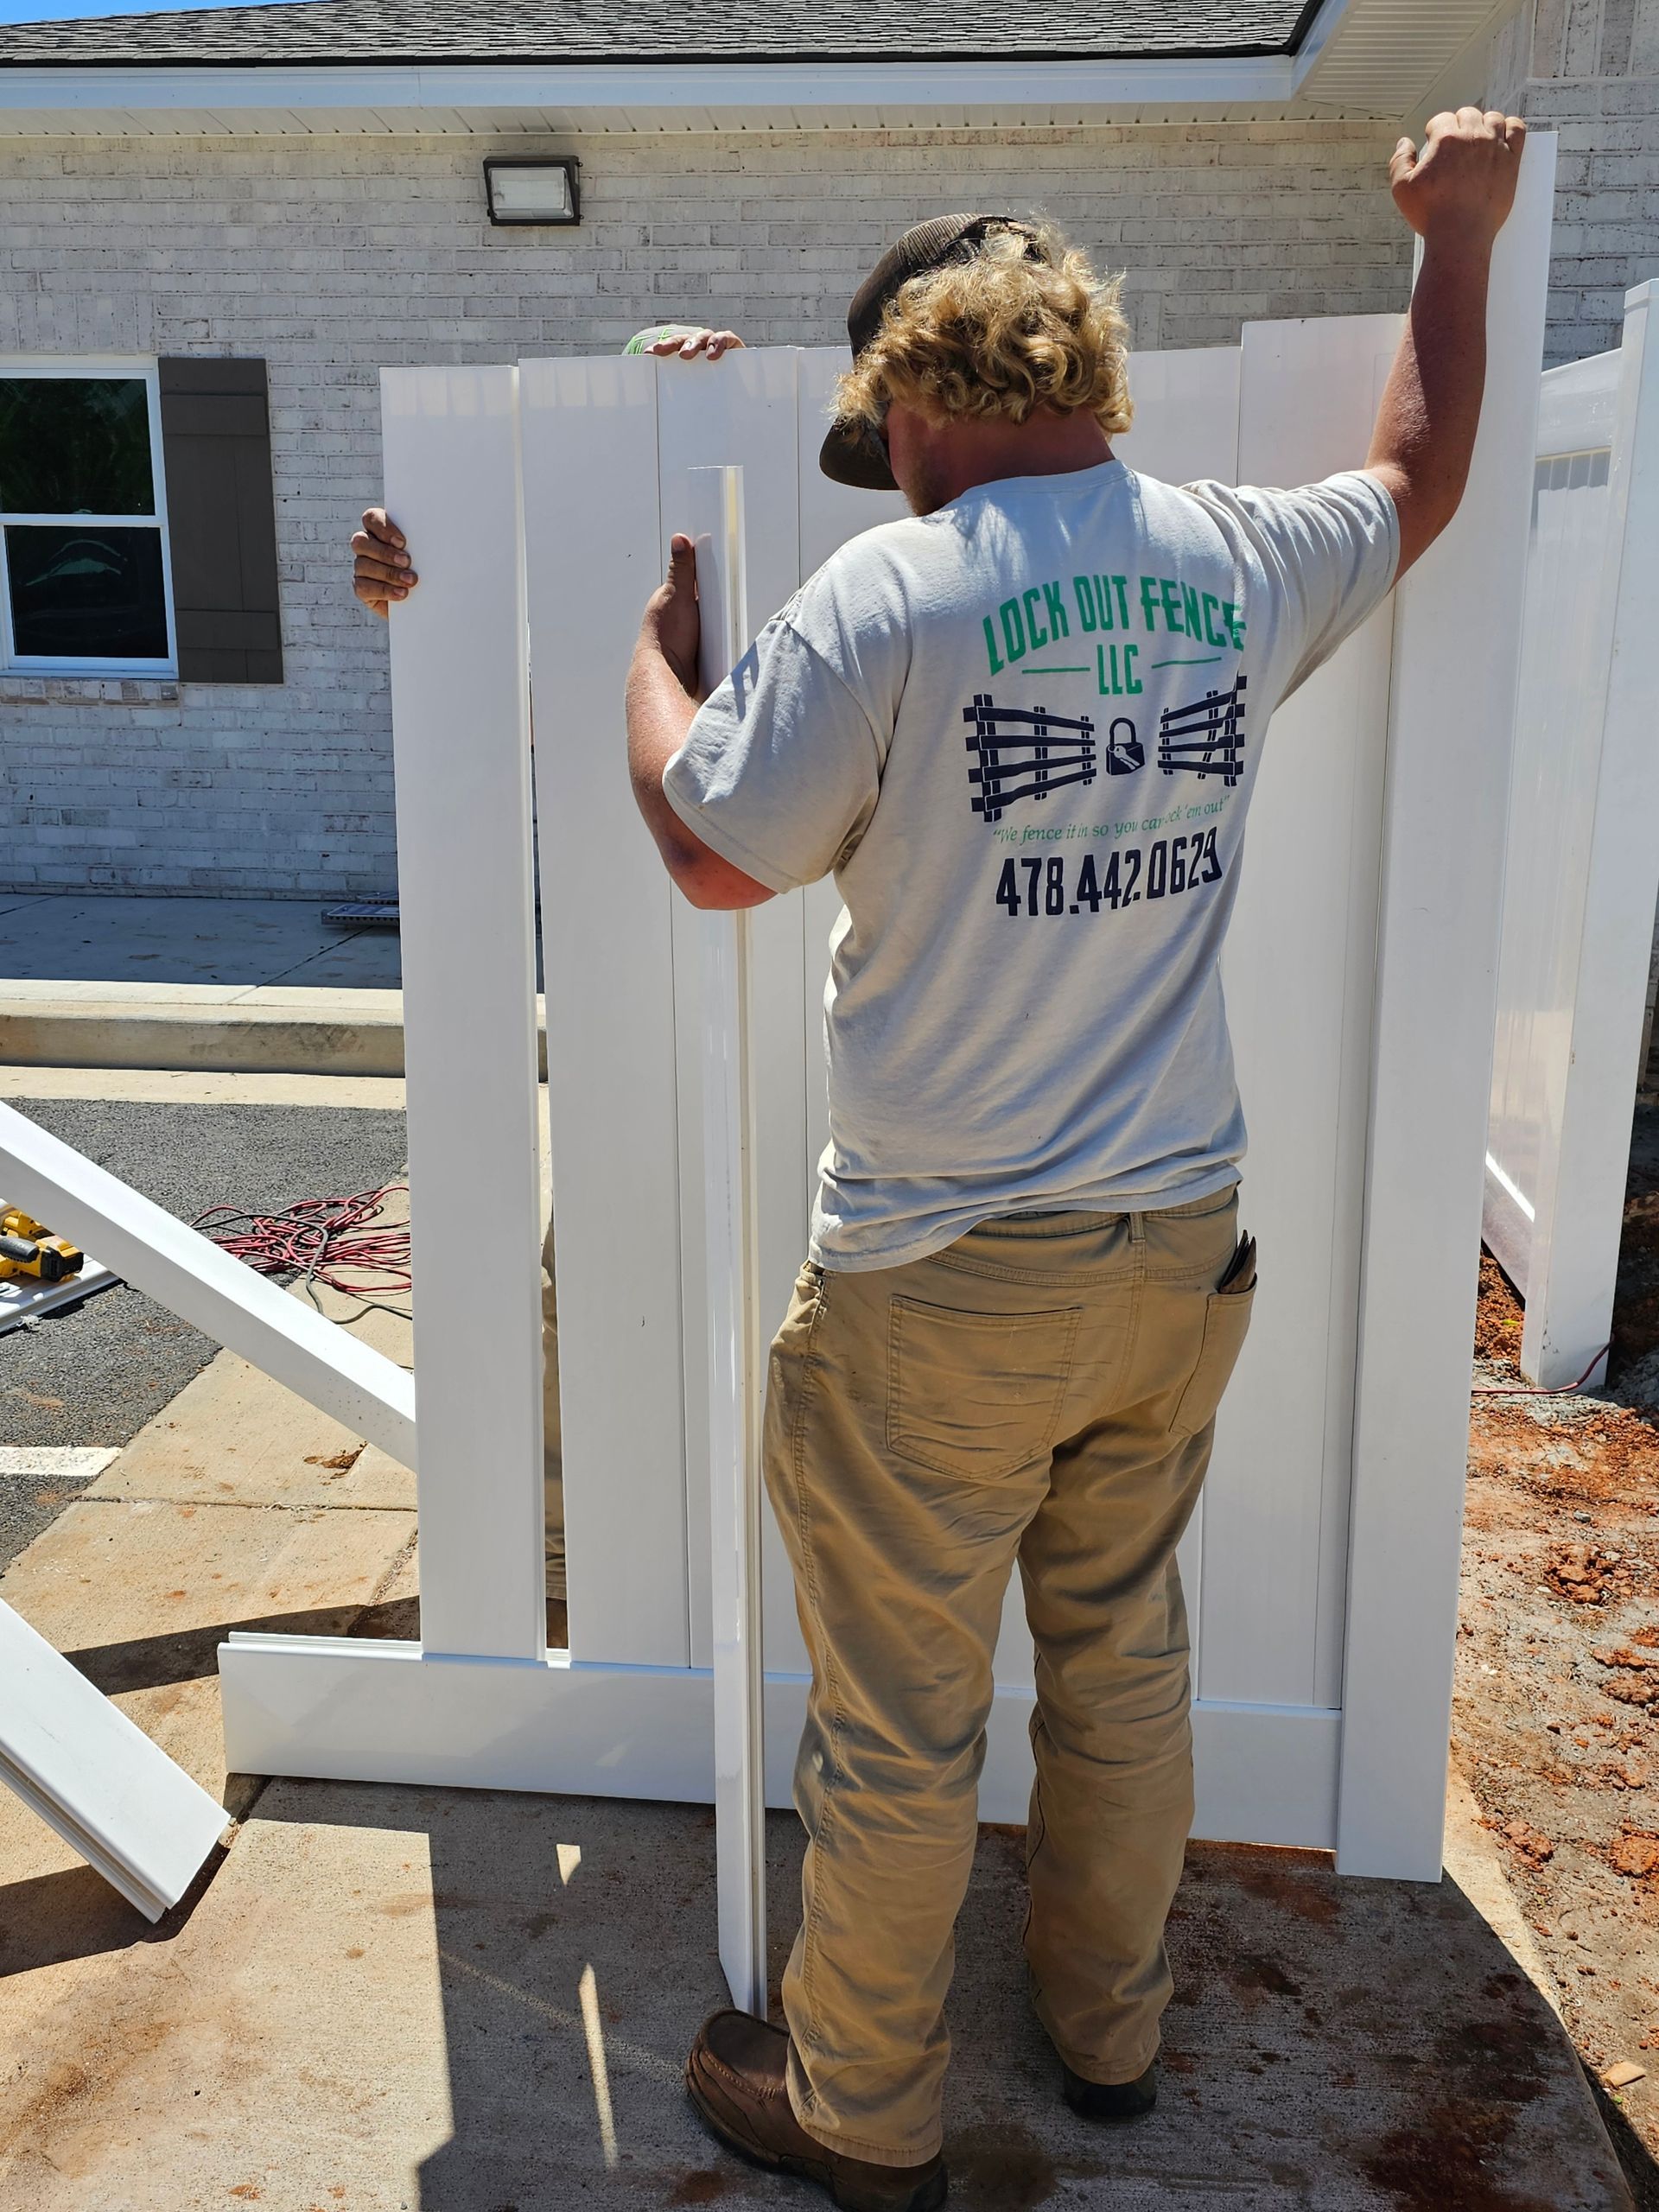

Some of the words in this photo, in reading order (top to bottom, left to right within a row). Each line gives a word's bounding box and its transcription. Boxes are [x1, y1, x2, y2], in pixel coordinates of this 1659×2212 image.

[982, 581, 1070, 677] LOCK
[1073, 575, 1129, 632] OUT
[1140, 575, 1247, 652] FENCE
[1096, 645, 1143, 695] LLC
[1020, 824, 1062, 846] fence
[1065, 823, 1077, 839] it
[1092, 824, 1109, 837] so
[1114, 821, 1139, 839] you
[995, 826, 1223, 917] 478.442.0629
